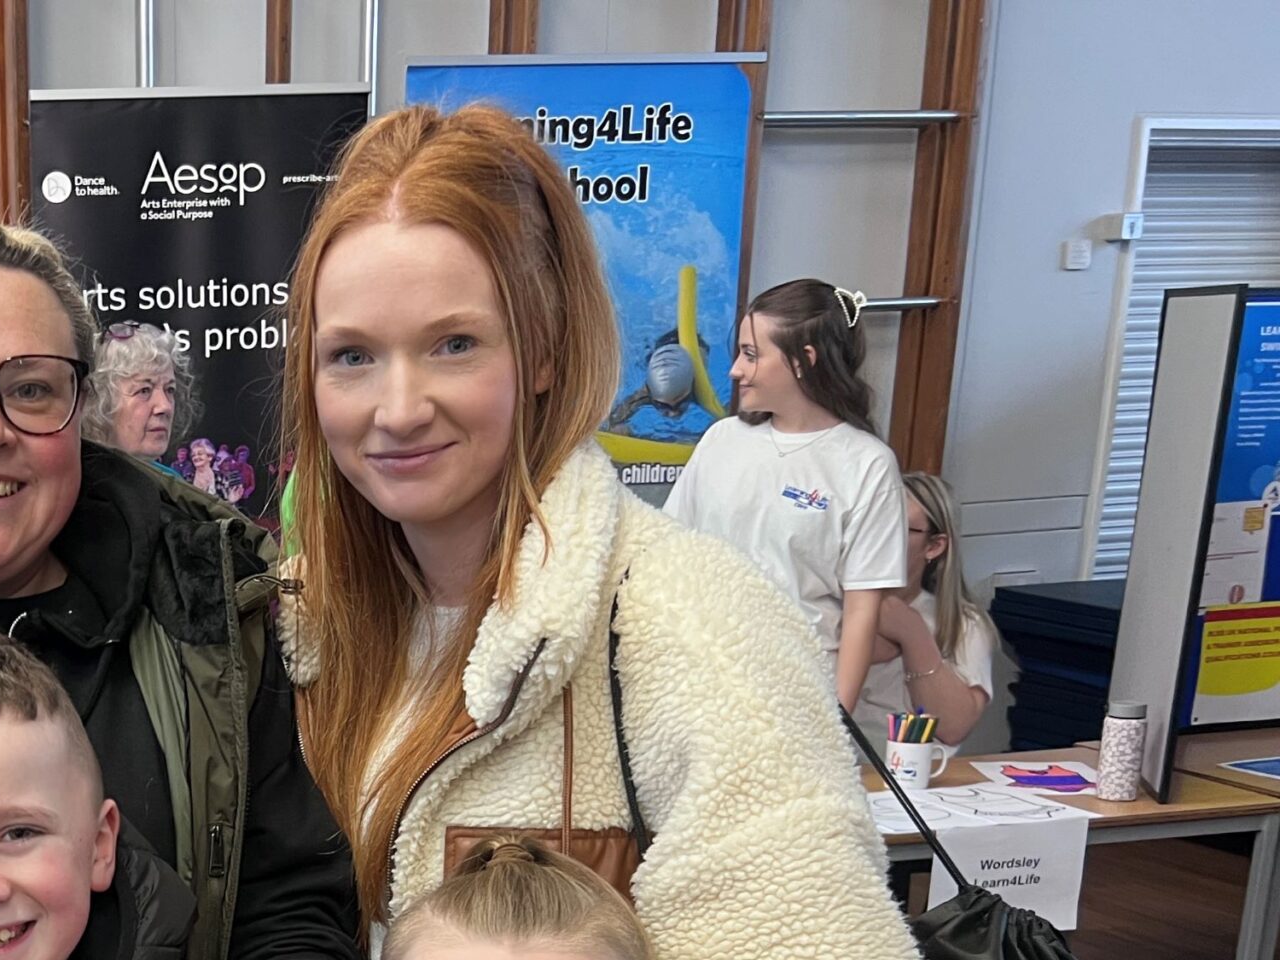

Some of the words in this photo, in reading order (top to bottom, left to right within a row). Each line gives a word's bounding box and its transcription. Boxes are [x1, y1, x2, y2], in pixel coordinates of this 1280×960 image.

[74, 176, 106, 187] Dance
[141, 151, 266, 206] Aesop
[75, 187, 86, 197] to
[140, 198, 161, 209] Arts
[161, 198, 208, 210] Enterprise
[209, 197, 231, 207] with
[140, 212, 148, 220] a
[148, 209, 175, 220] Social
[176, 209, 213, 221] Purpose
[83, 282, 126, 312] rts
[138, 278, 289, 310] solutions
[204, 318, 288, 359] probl
[980, 856, 1041, 870] Wordsley
